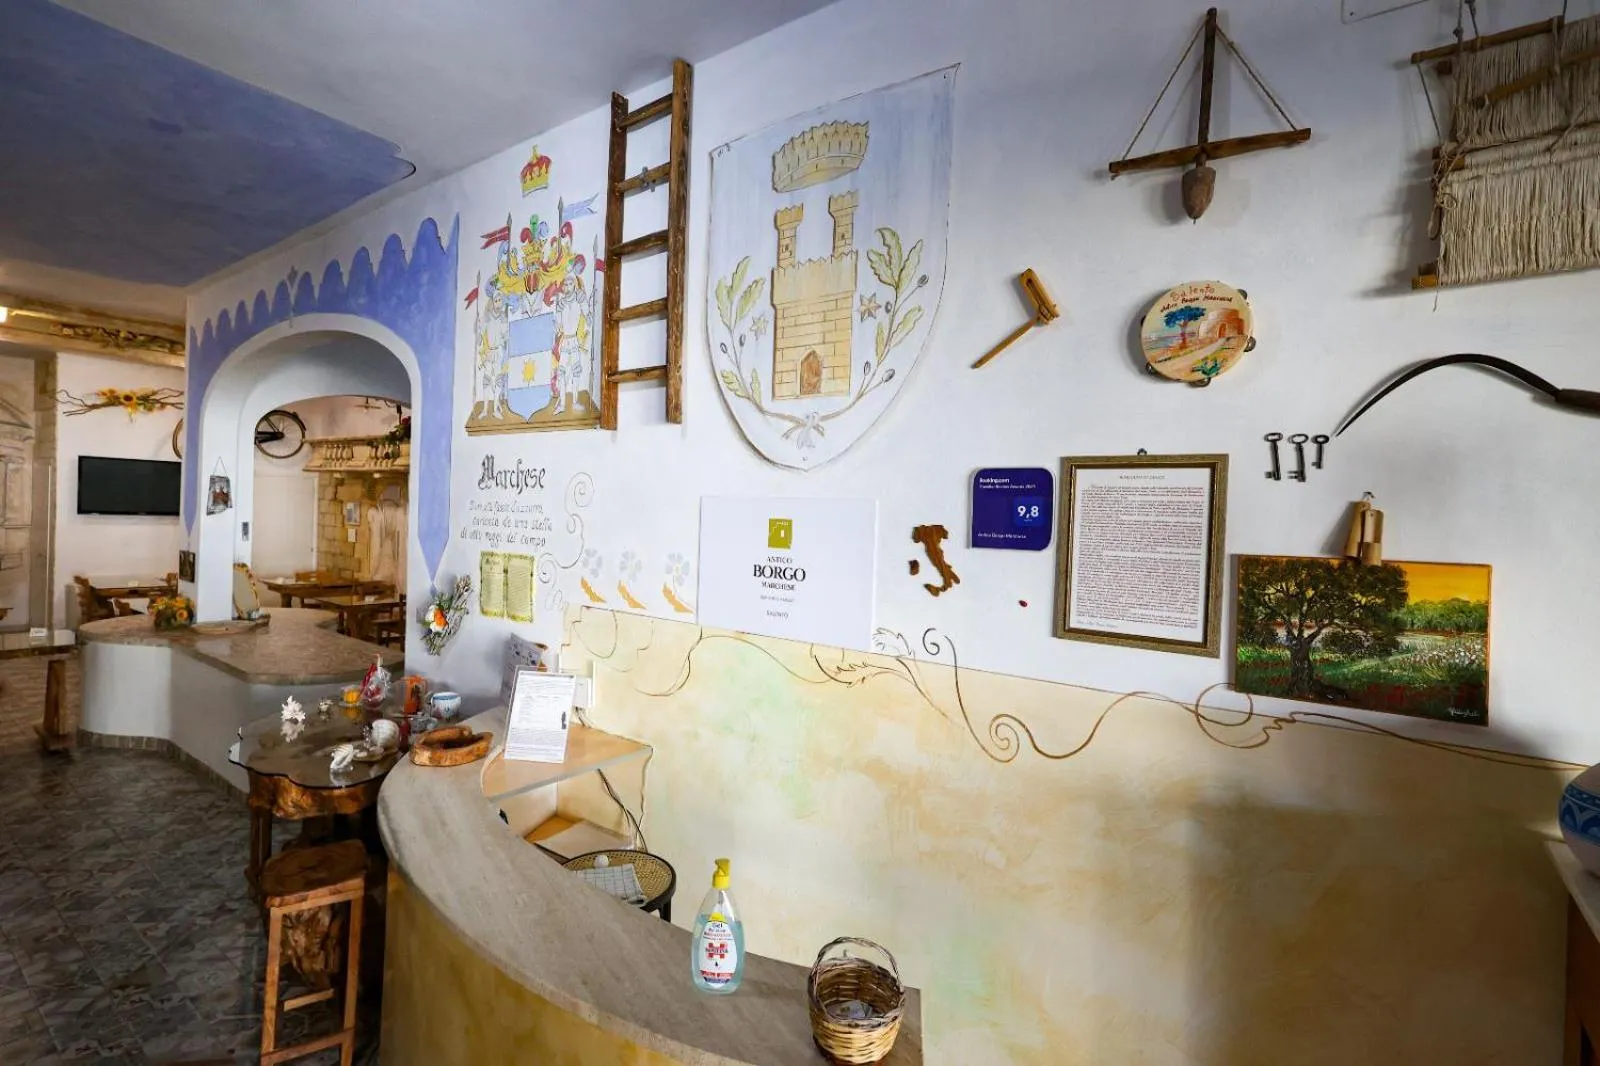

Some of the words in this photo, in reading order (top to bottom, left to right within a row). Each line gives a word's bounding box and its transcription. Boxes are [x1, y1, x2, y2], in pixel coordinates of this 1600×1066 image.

[478, 454, 546, 494] Marchese
[1017, 505, 1039, 519] 9,8
[767, 556, 793, 564] ANTICO
[753, 564, 806, 582] BORGO
